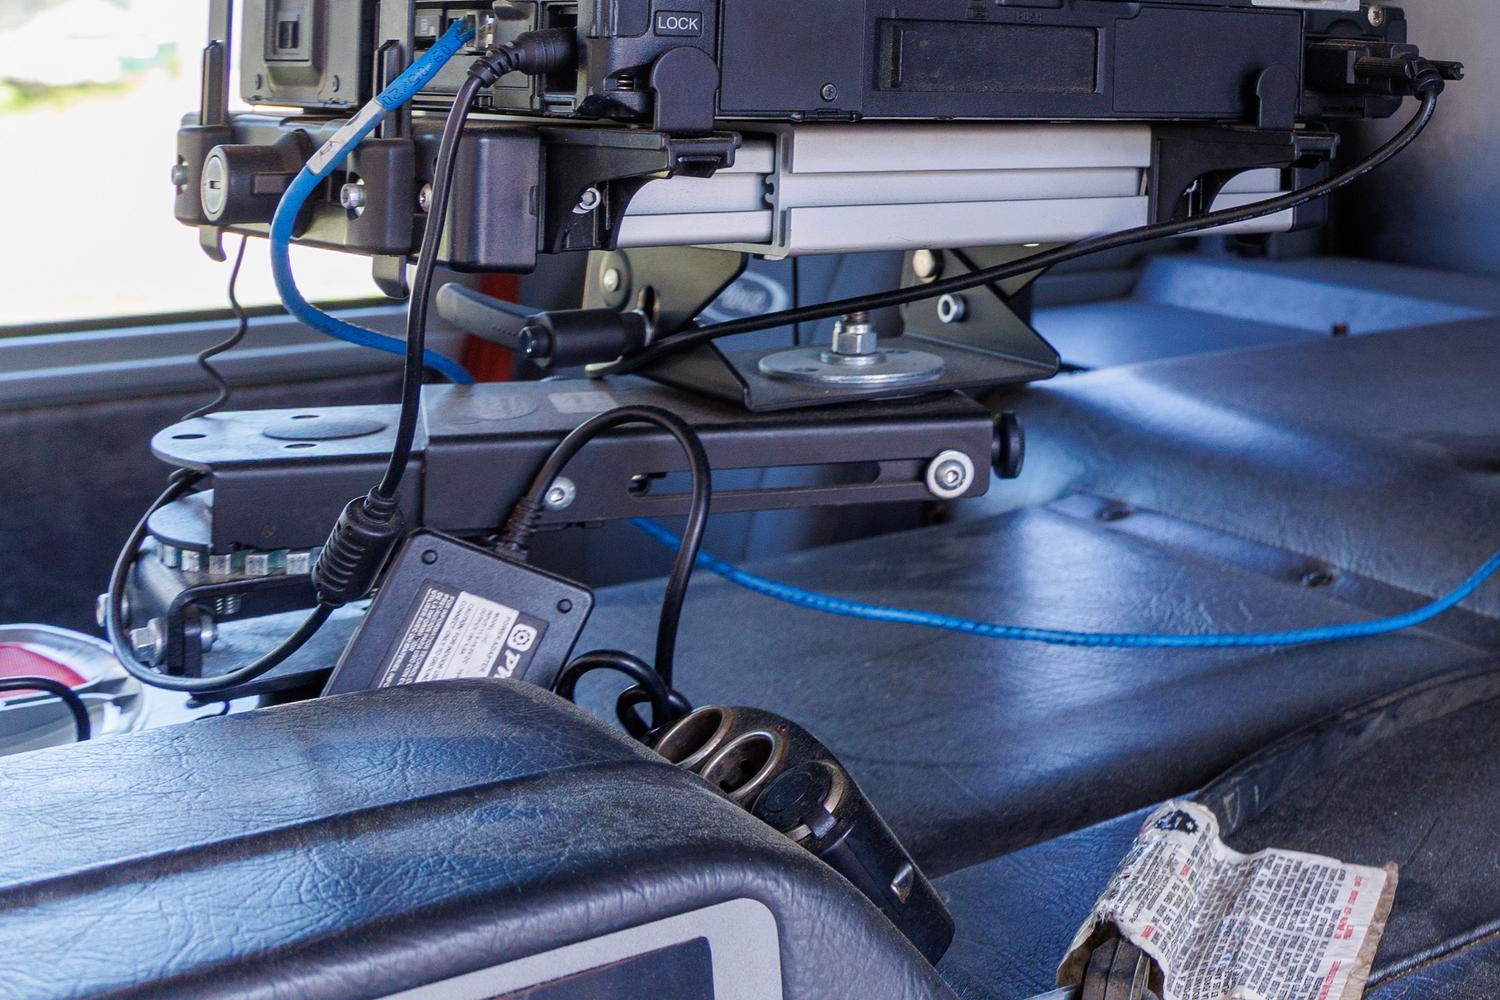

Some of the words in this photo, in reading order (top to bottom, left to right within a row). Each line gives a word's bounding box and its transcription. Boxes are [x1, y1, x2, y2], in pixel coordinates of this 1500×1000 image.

[658, 16, 698, 30] LOCK
[449, 600, 467, 629] CONNECT
[495, 615, 510, 640] POWER
[479, 640, 498, 673] ADAPTER
